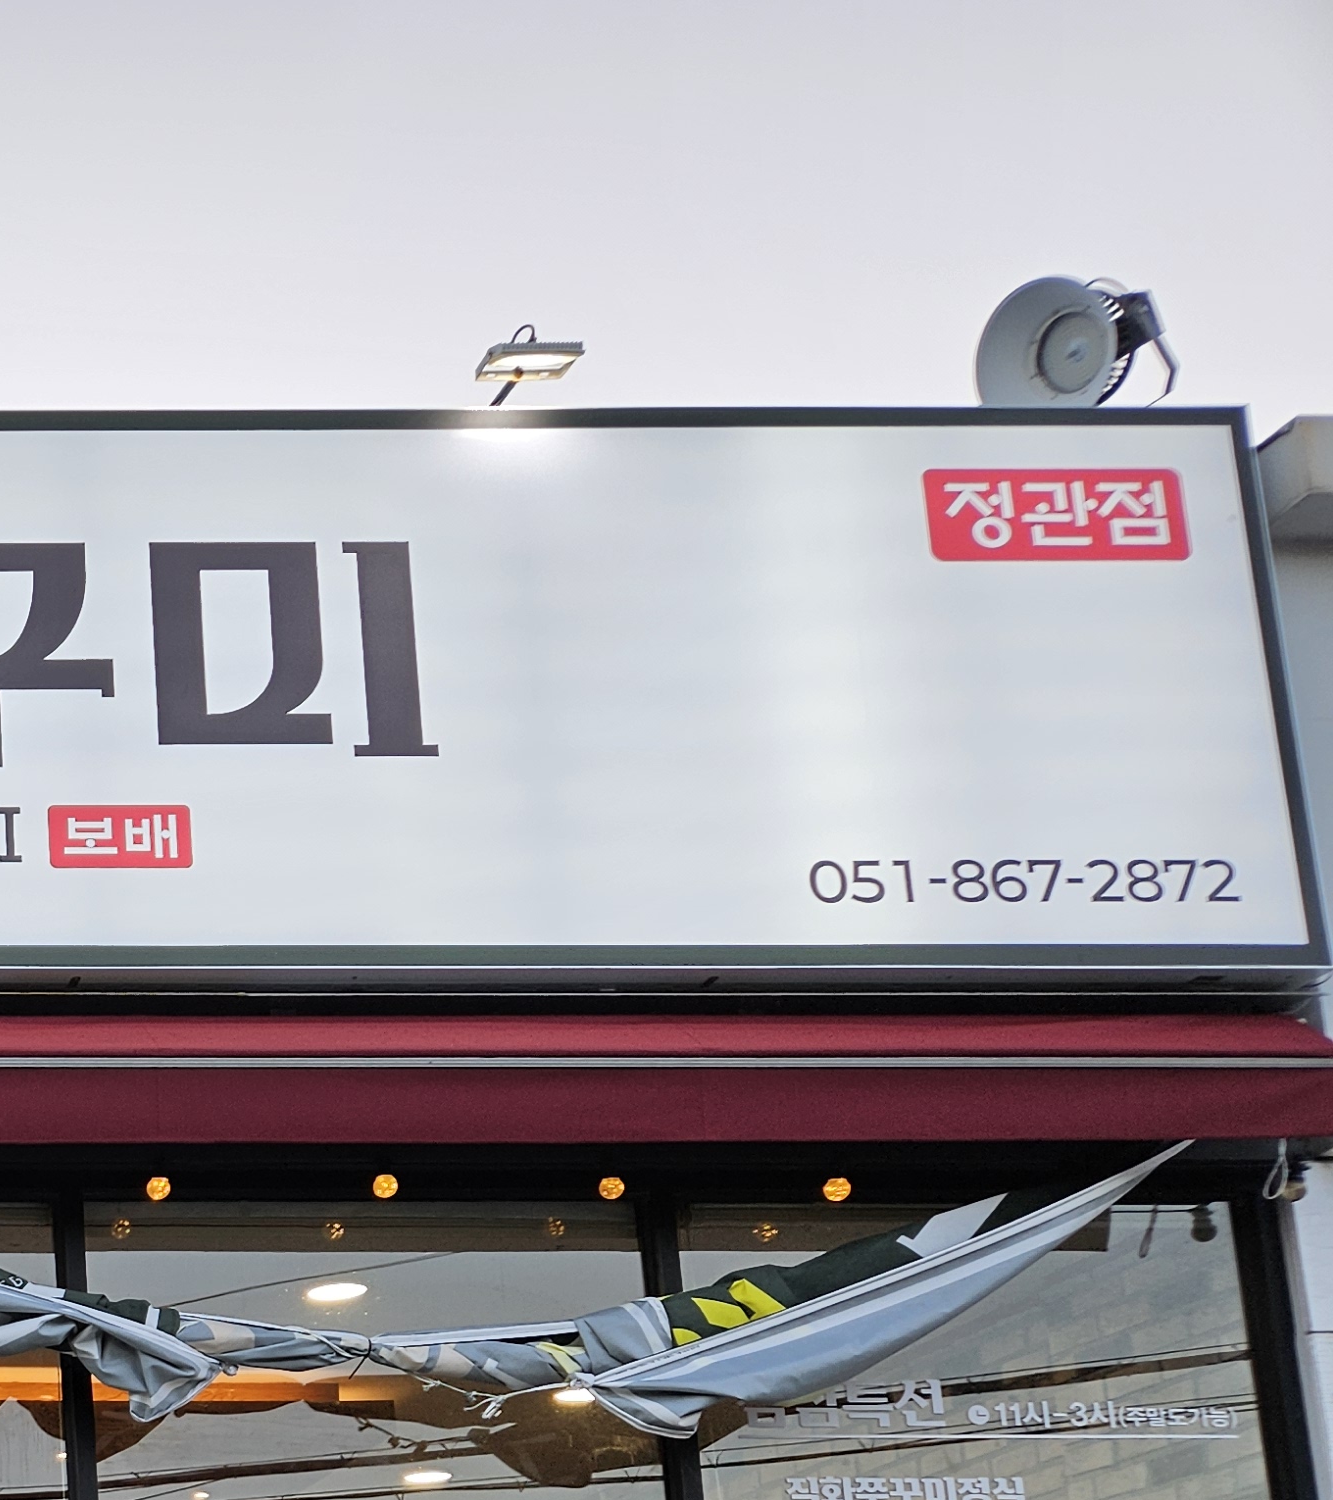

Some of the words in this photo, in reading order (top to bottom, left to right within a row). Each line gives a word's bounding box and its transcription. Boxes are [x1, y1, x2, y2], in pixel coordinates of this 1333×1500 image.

[943, 479, 1173, 550] 정관점
[62, 812, 181, 862] 보배
[808, 858, 1242, 905] 051-867-2872
